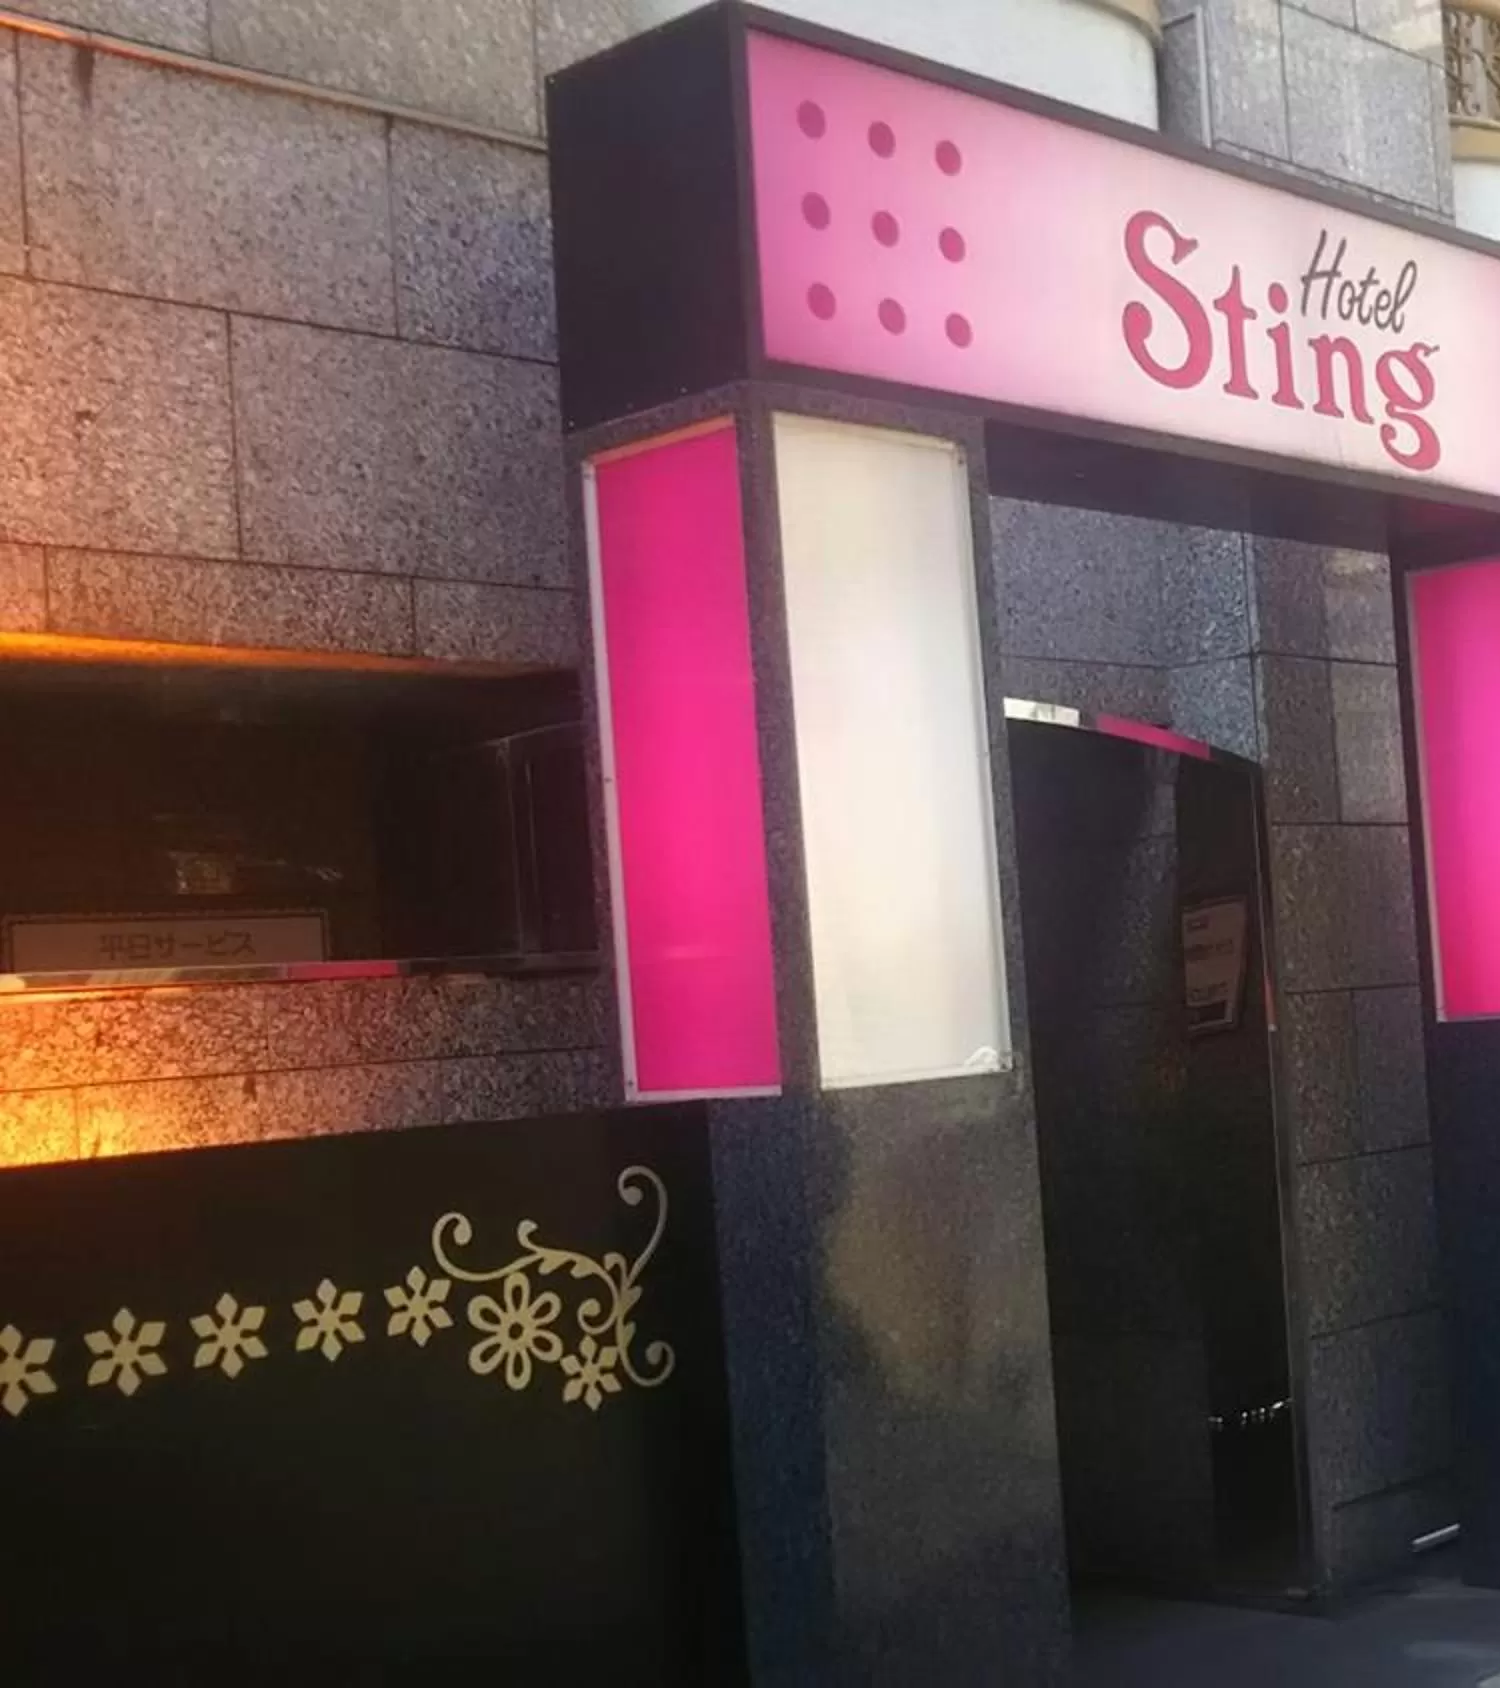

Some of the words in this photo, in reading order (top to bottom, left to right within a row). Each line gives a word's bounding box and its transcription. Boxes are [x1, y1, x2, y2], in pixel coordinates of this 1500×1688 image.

[1300, 229, 1417, 333] Hotel
[1122, 210, 1440, 471] Sting
[97, 929, 257, 961] 平日サービス
